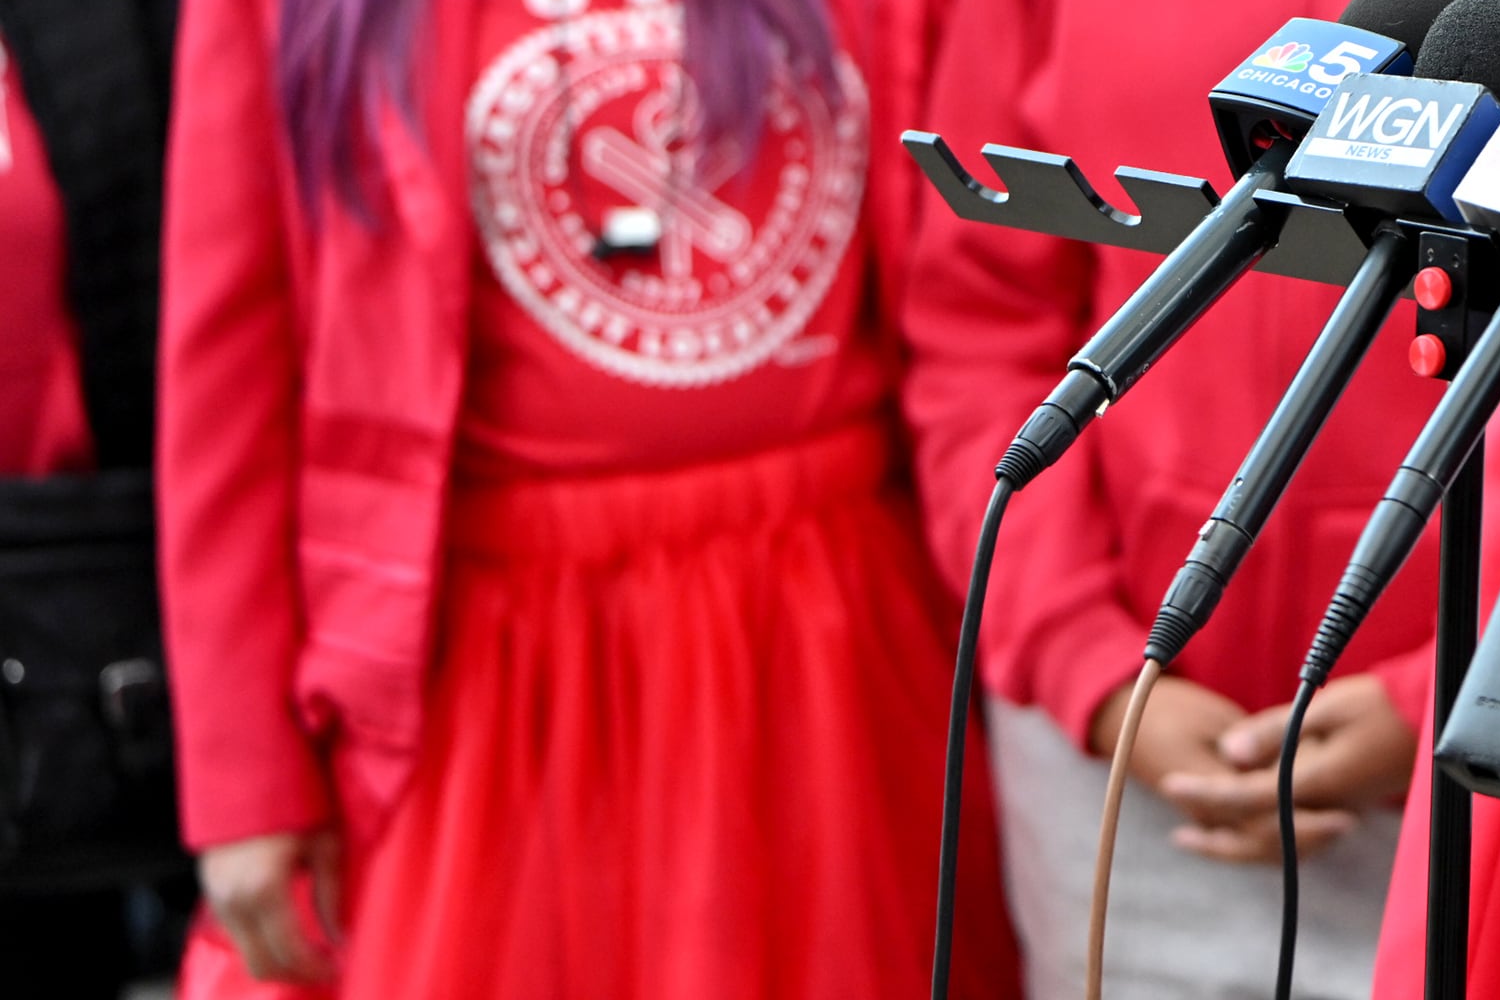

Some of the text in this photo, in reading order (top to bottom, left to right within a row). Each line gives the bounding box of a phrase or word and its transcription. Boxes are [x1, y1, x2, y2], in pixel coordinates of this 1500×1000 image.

[1308, 41, 1380, 85] 5
[1237, 67, 1332, 100] CHICAGO
[1326, 92, 1464, 149] WGN
[1344, 144, 1393, 161] NEWS
